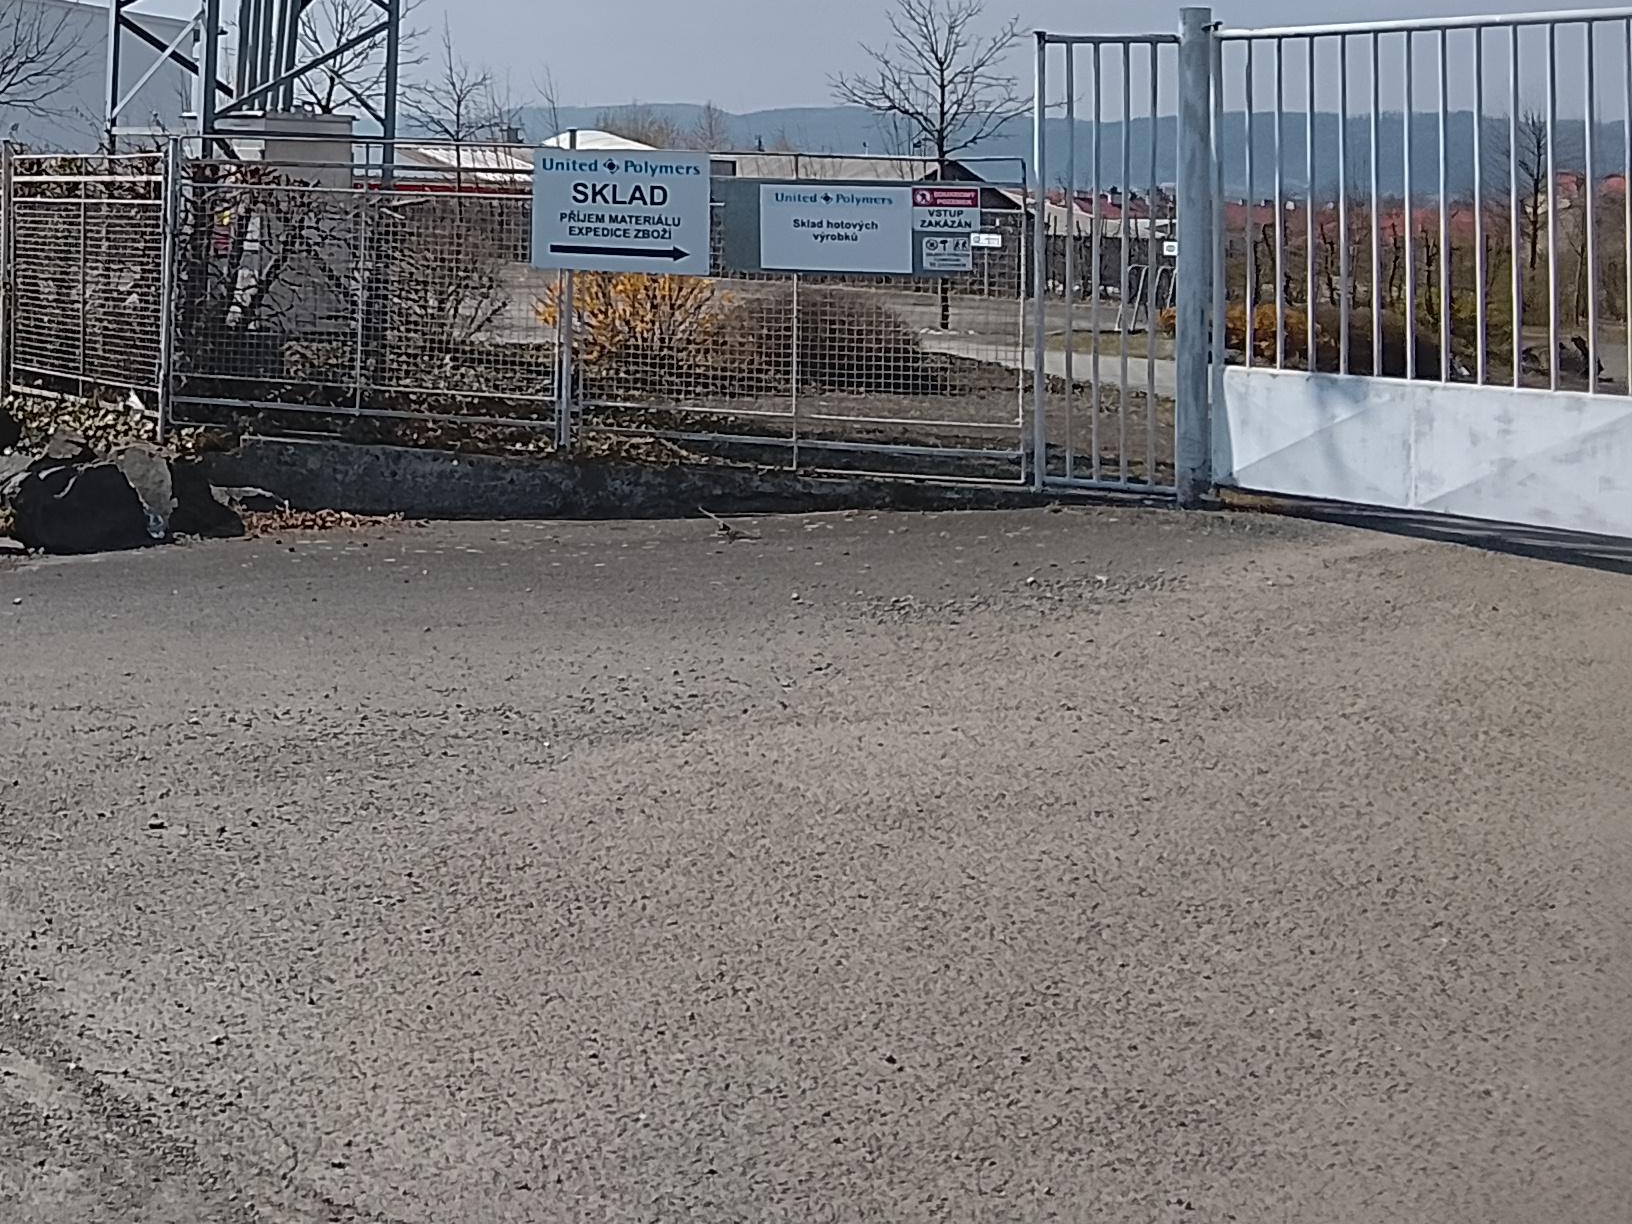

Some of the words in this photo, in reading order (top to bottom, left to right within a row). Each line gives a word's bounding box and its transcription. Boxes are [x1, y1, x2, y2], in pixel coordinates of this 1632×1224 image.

[542, 158, 598, 172] United
[624, 160, 701, 177] Polymers
[571, 182, 668, 206] SKLAD
[775, 192, 817, 204] United
[836, 193, 893, 206] Polymers
[559, 211, 605, 224] PŘÍJEM
[609, 213, 681, 227] MATERIÁLU
[928, 209, 964, 218] VSTUP
[793, 218, 823, 229] Sklad
[826, 219, 878, 231] hotových
[920, 219, 972, 229] ZAKÁZÁN
[569, 227, 631, 239] EXPEDICE
[634, 228, 672, 240] ZBOŽÍ
[812, 231, 858, 242] výrobků
